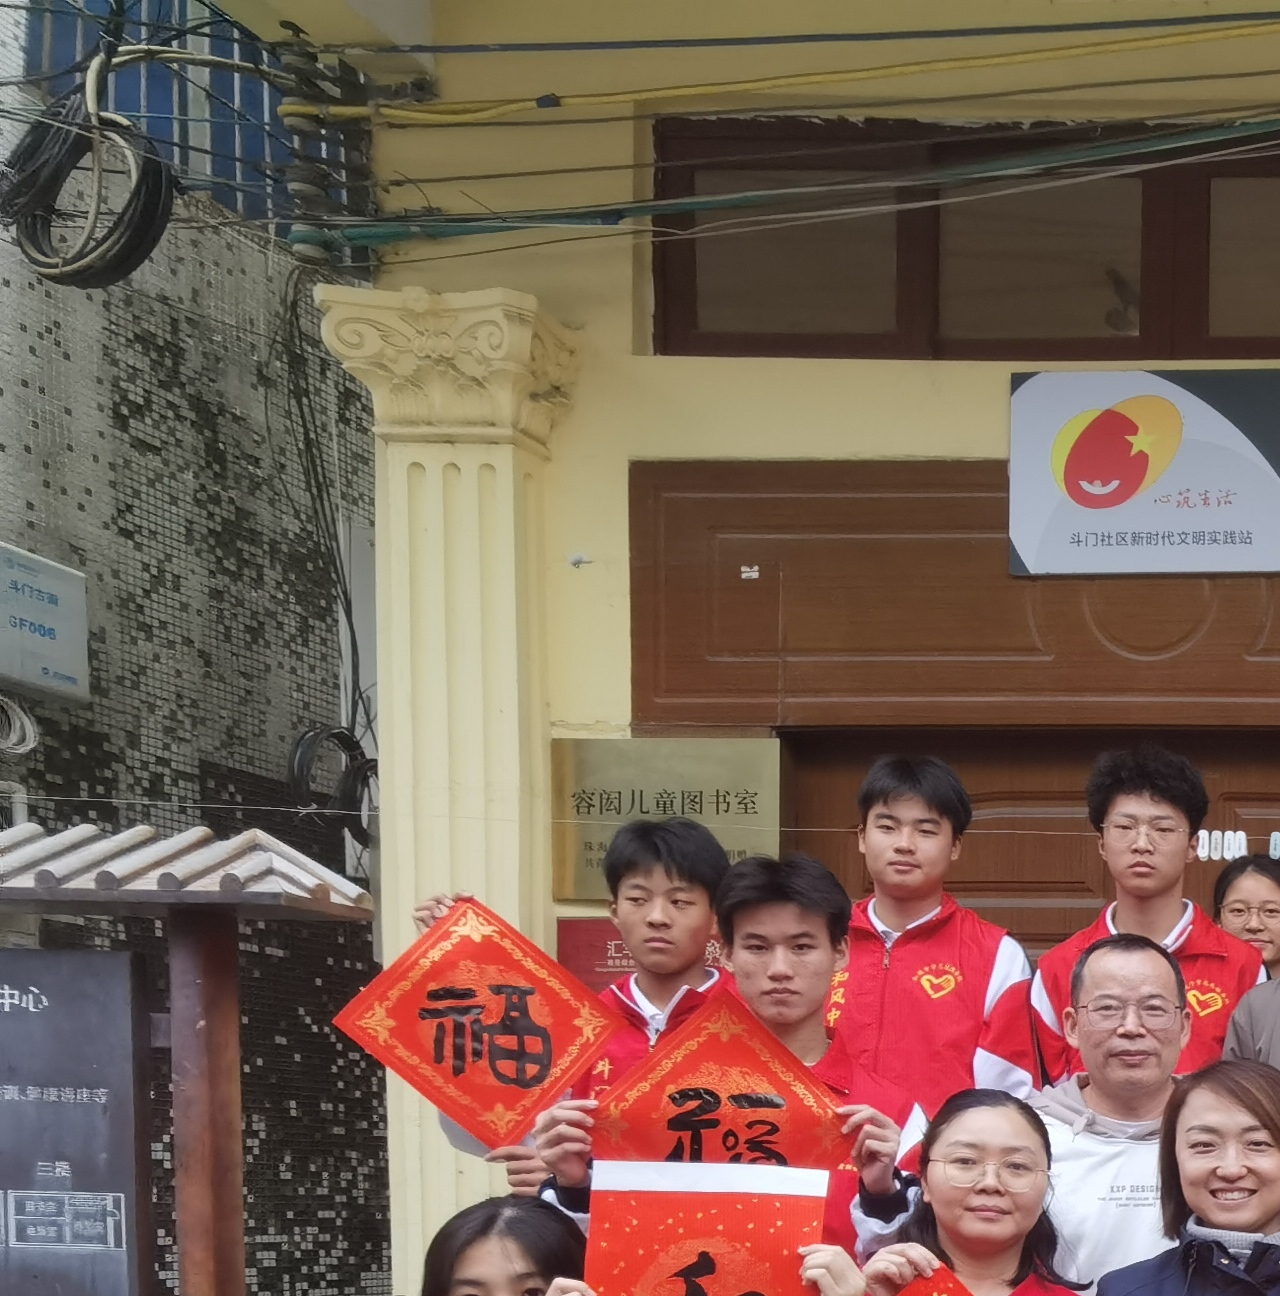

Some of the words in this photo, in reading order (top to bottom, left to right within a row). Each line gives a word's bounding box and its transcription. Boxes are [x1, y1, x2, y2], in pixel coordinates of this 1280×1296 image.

[1069, 530, 1253, 547] 斗门社区新时代文明实践站
[571, 788, 759, 816] 容闳儿童图书室
[827, 971, 849, 1027] 和风中
[419, 984, 553, 1090] 福
